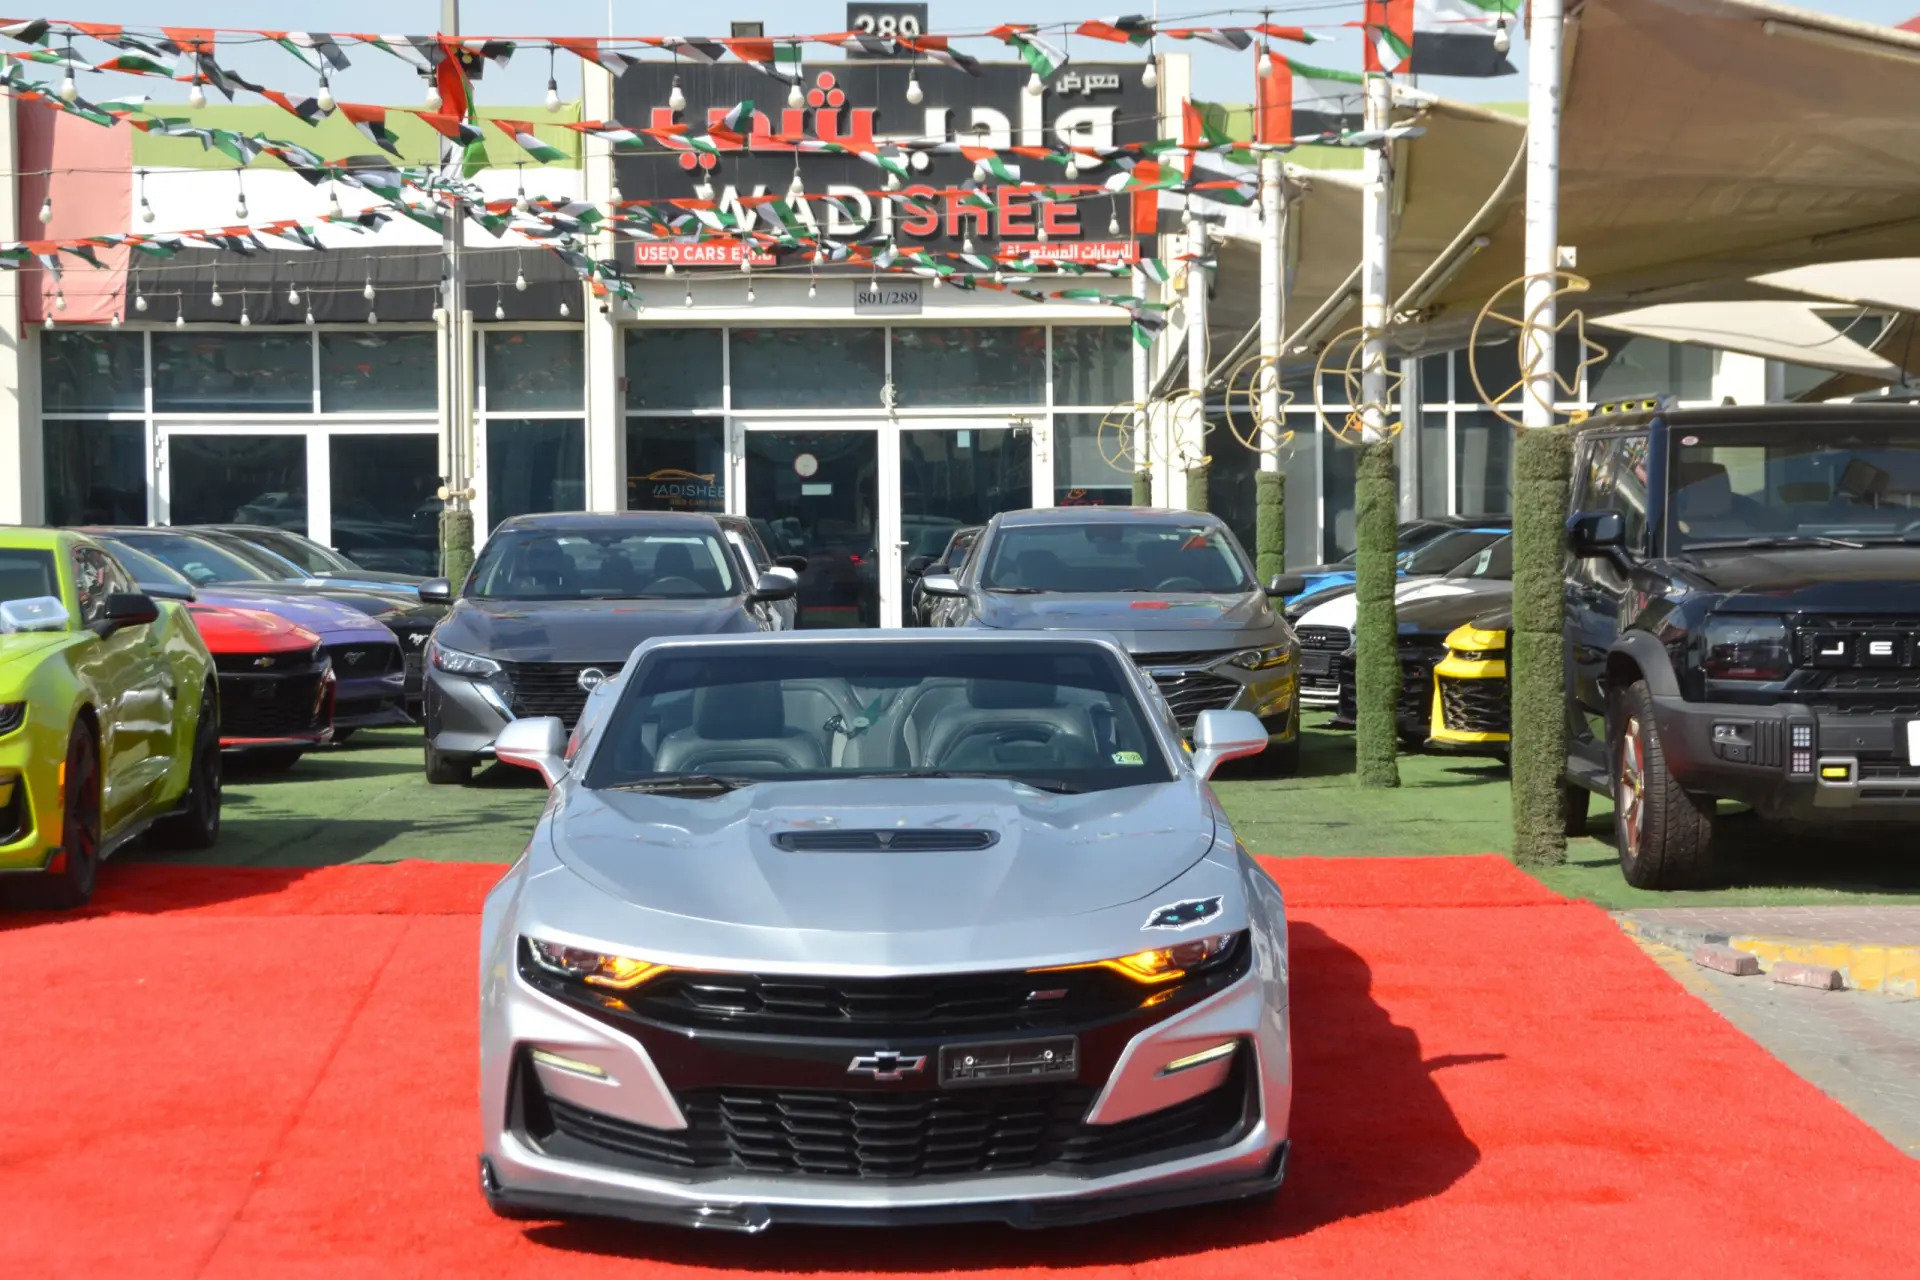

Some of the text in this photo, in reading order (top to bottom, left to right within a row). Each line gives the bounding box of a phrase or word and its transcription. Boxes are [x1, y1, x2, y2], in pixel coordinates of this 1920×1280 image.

[854, 13, 920, 41] 289
[1055, 71, 1119, 95] معرض
[638, 246, 679, 261] USED
[683, 246, 725, 261] CARS
[858, 291, 918, 305] 801/289
[1821, 641, 1920, 655] JE
